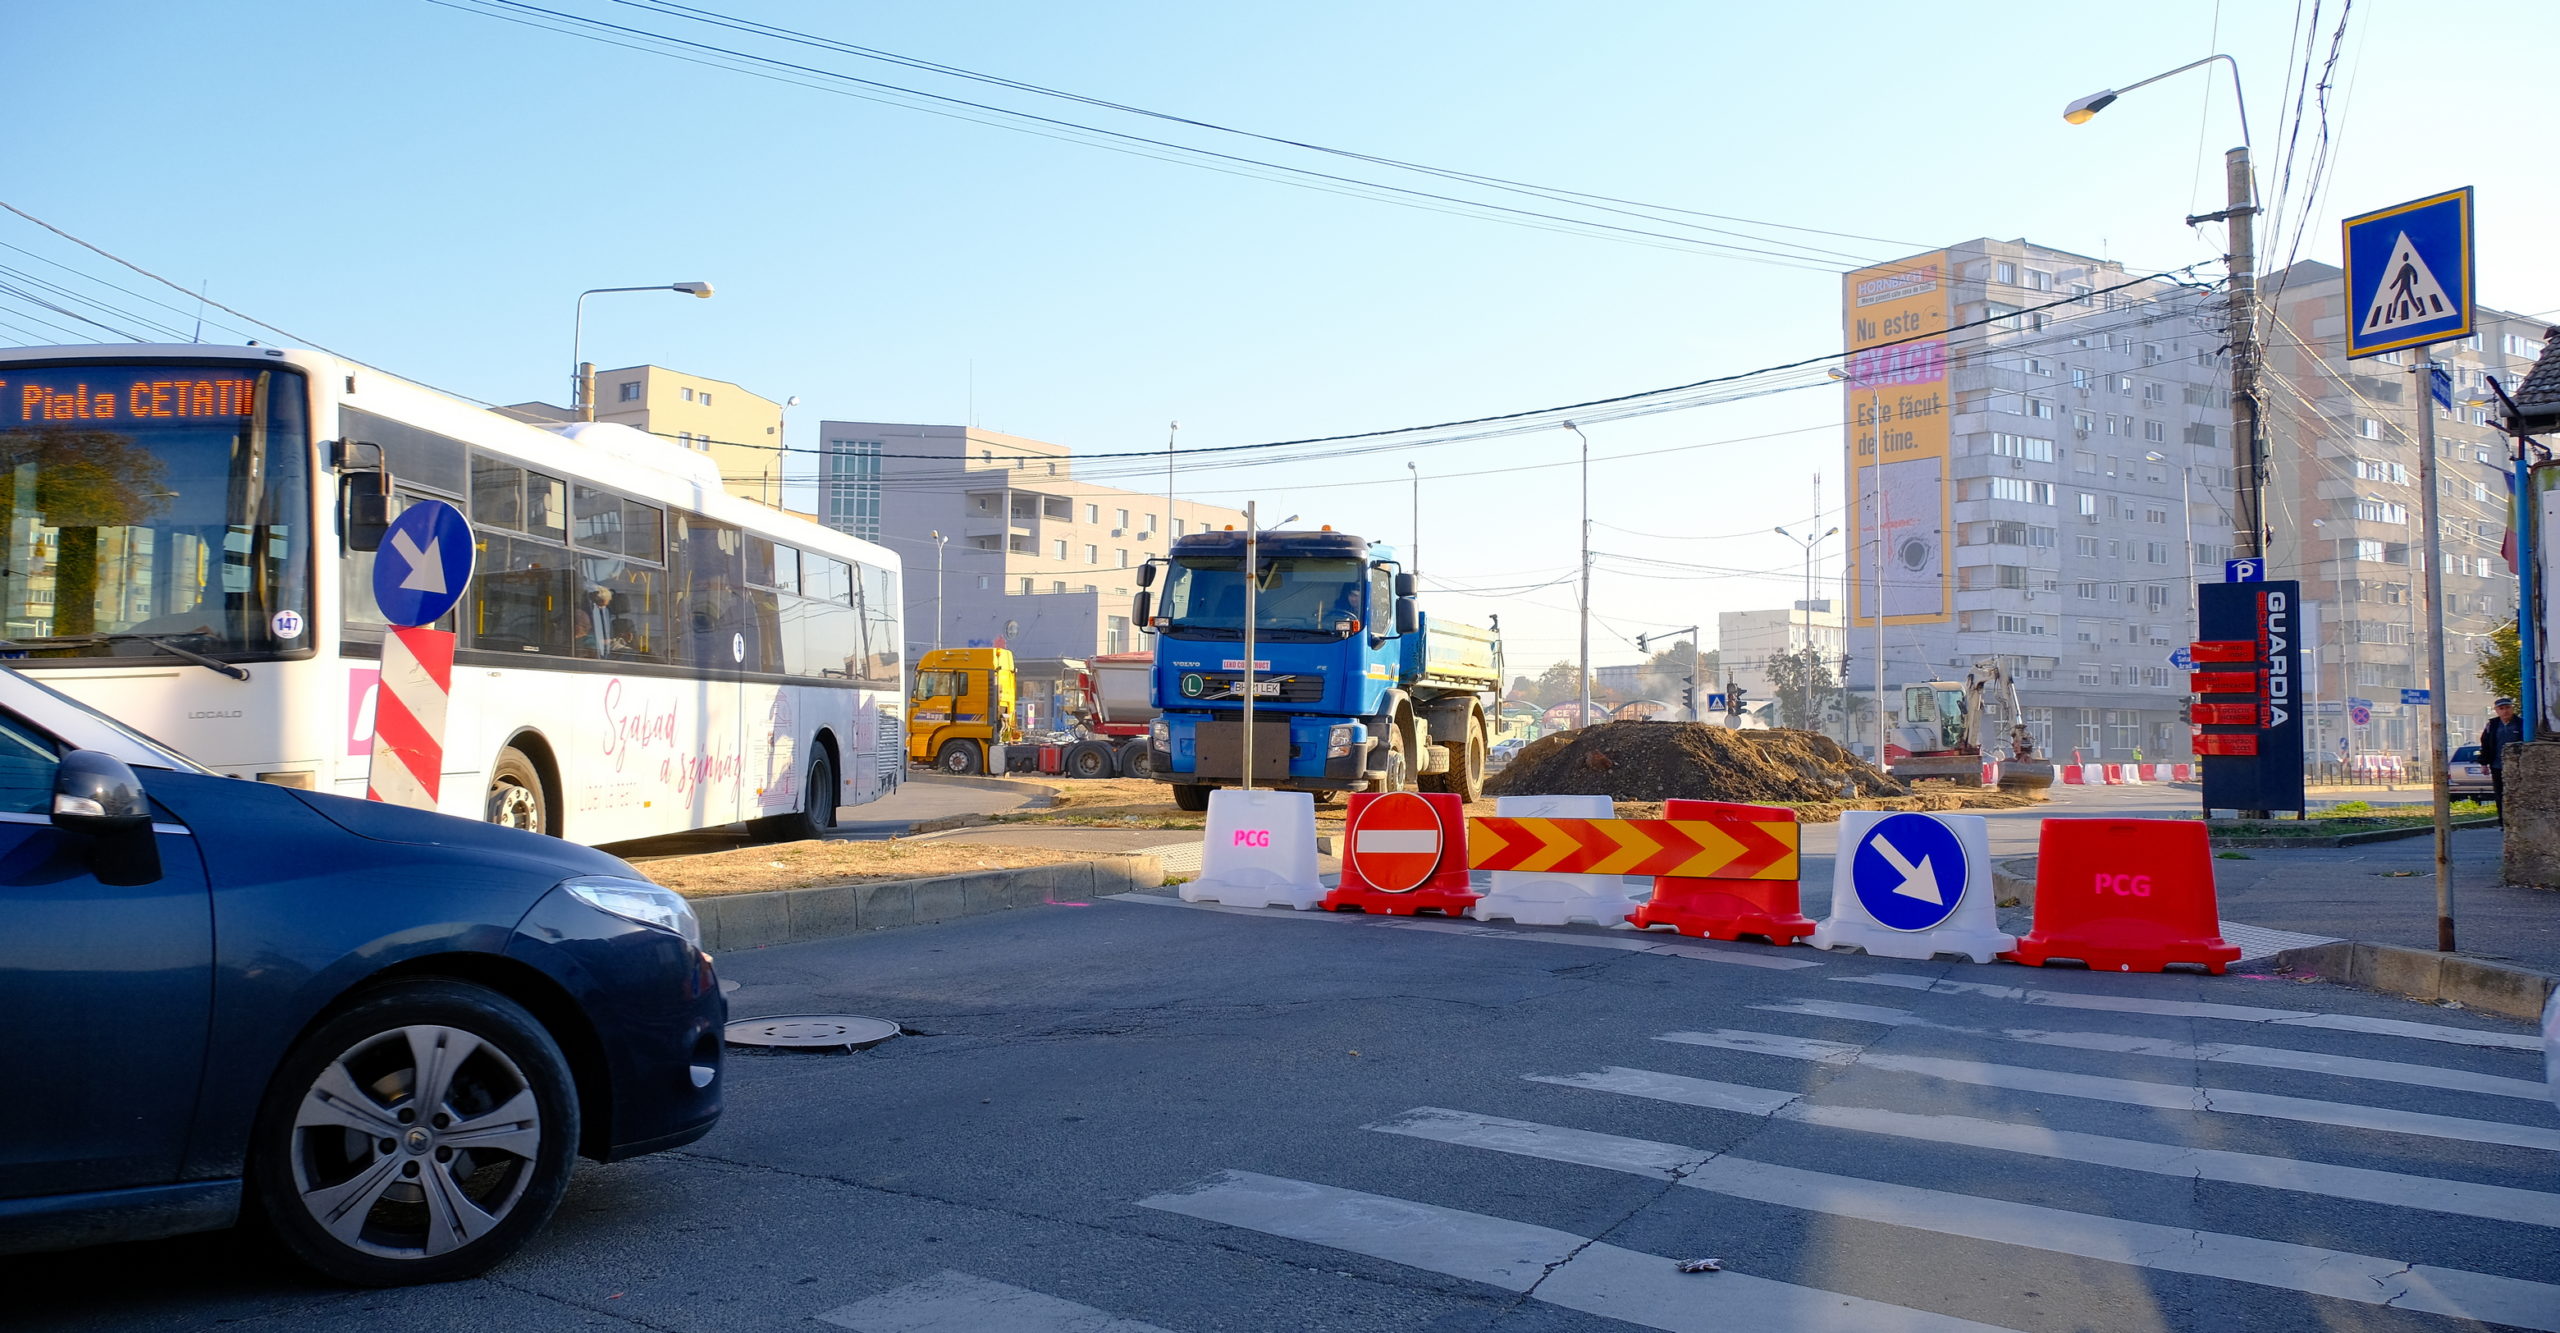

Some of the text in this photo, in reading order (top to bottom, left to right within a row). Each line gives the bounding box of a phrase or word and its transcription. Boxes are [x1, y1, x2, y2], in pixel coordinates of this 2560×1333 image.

[1859, 270, 1922, 295] HORNBACH
[1856, 310, 1920, 342] Nu este
[1855, 342, 1943, 387] EXACT.
[130, 380, 253, 418] CETATII
[1898, 392, 1941, 421] făcut
[1858, 428, 1918, 457] de tine.
[2237, 564, 2254, 582] P
[276, 617, 298, 631] 147
[1237, 661, 1269, 669] CORUCT
[2256, 591, 2271, 729] SECURITY SYSTEM
[2267, 591, 2288, 728] GUARDIA
[1188, 677, 1197, 693] L
[1261, 684, 1279, 693] LEK
[188, 710, 242, 719] LOCALO
[602, 678, 678, 774] Szabad
[660, 757, 671, 784] a
[1234, 829, 1269, 847] PCG
[2095, 873, 2151, 897] PCG
